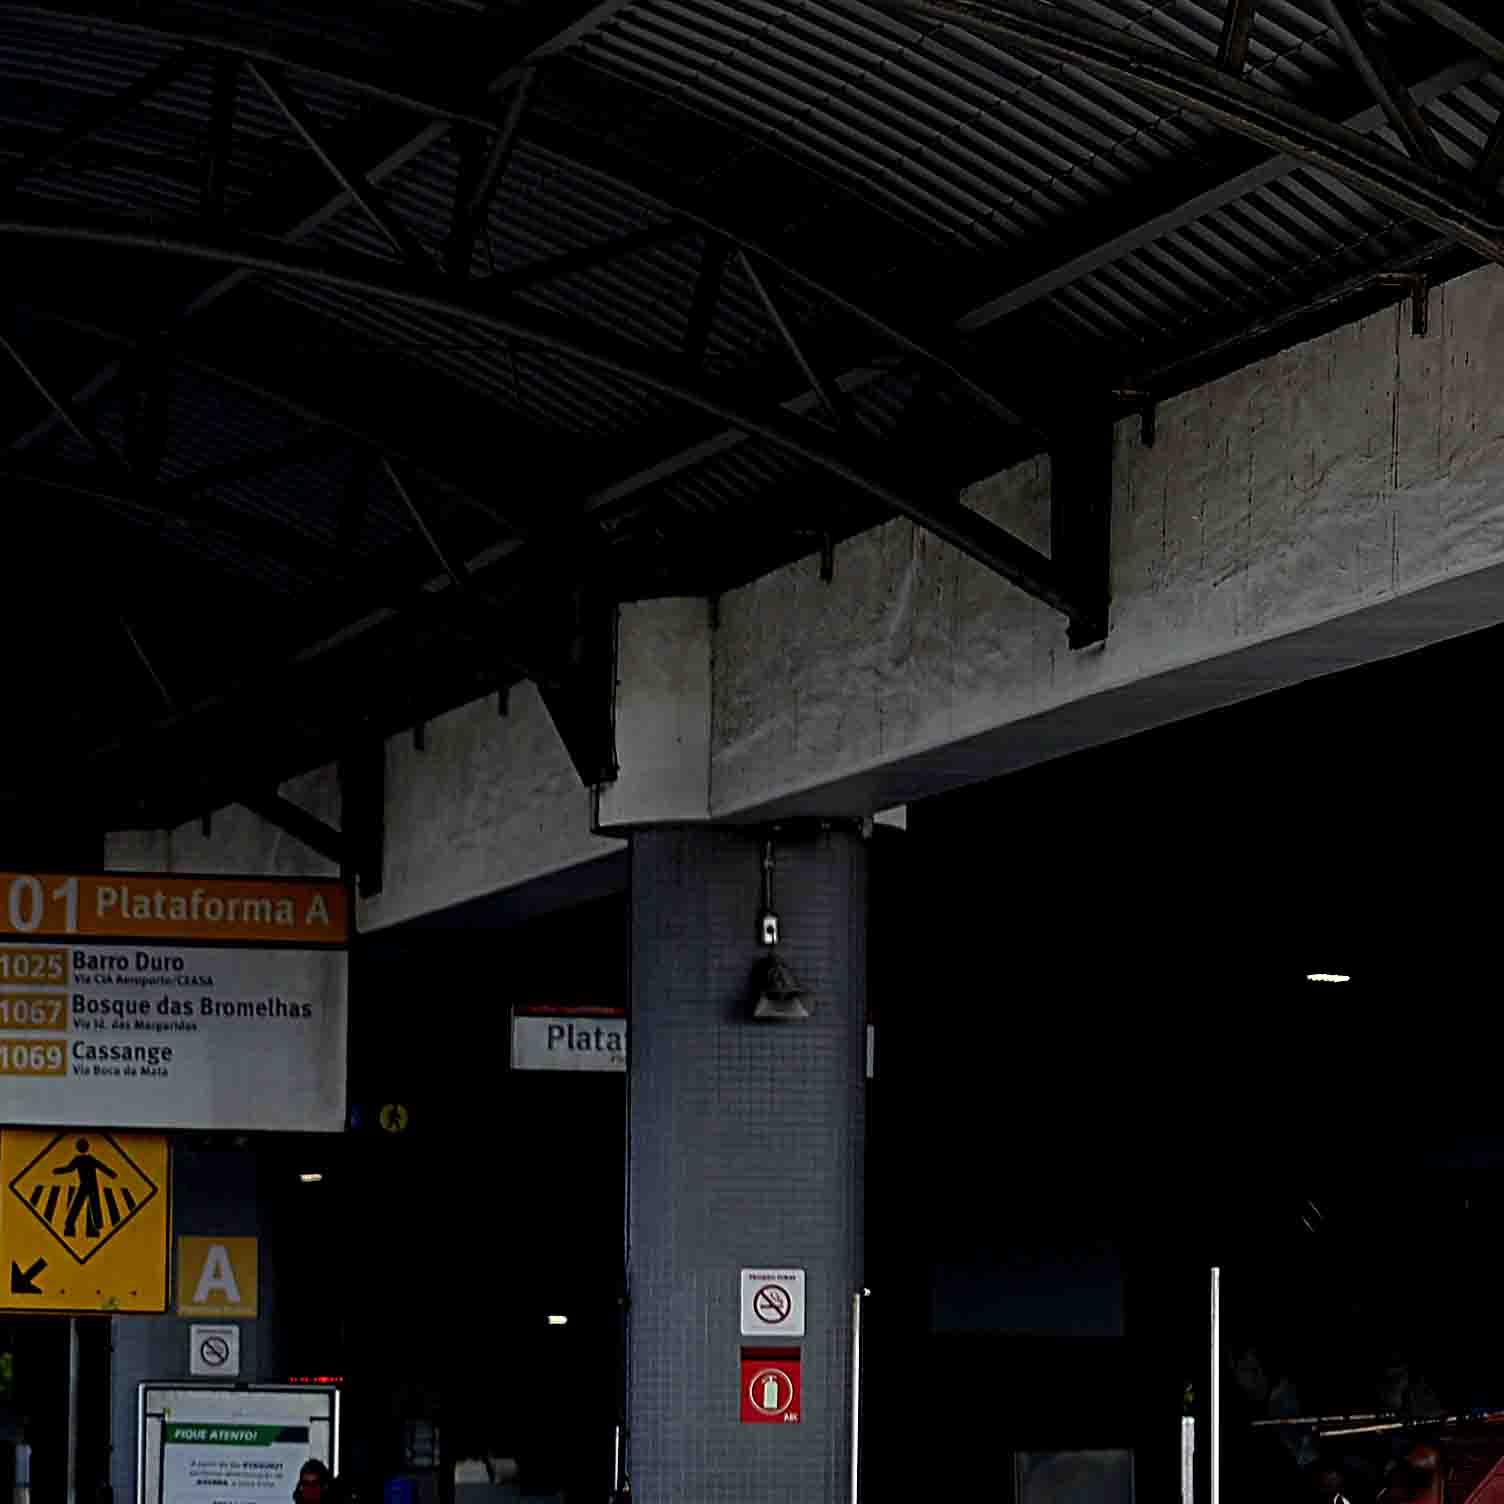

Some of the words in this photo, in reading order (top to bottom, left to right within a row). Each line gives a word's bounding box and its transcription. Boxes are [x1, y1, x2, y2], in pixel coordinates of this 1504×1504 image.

[7, 874, 80, 934] 01
[95, 885, 296, 925] Plataforma
[305, 893, 330, 926] A
[0, 953, 64, 978] 1025
[72, 950, 129, 970] Barro
[135, 951, 185, 971] Duro
[73, 974, 90, 985] Via
[72, 993, 152, 1018] Bosque
[156, 994, 194, 1015] das
[73, 1018, 90, 1030] Via
[547, 1022, 630, 1051] Plata
[72, 1039, 173, 1065] Cassange
[73, 1064, 90, 1076] Via
[192, 1243, 240, 1303] A
